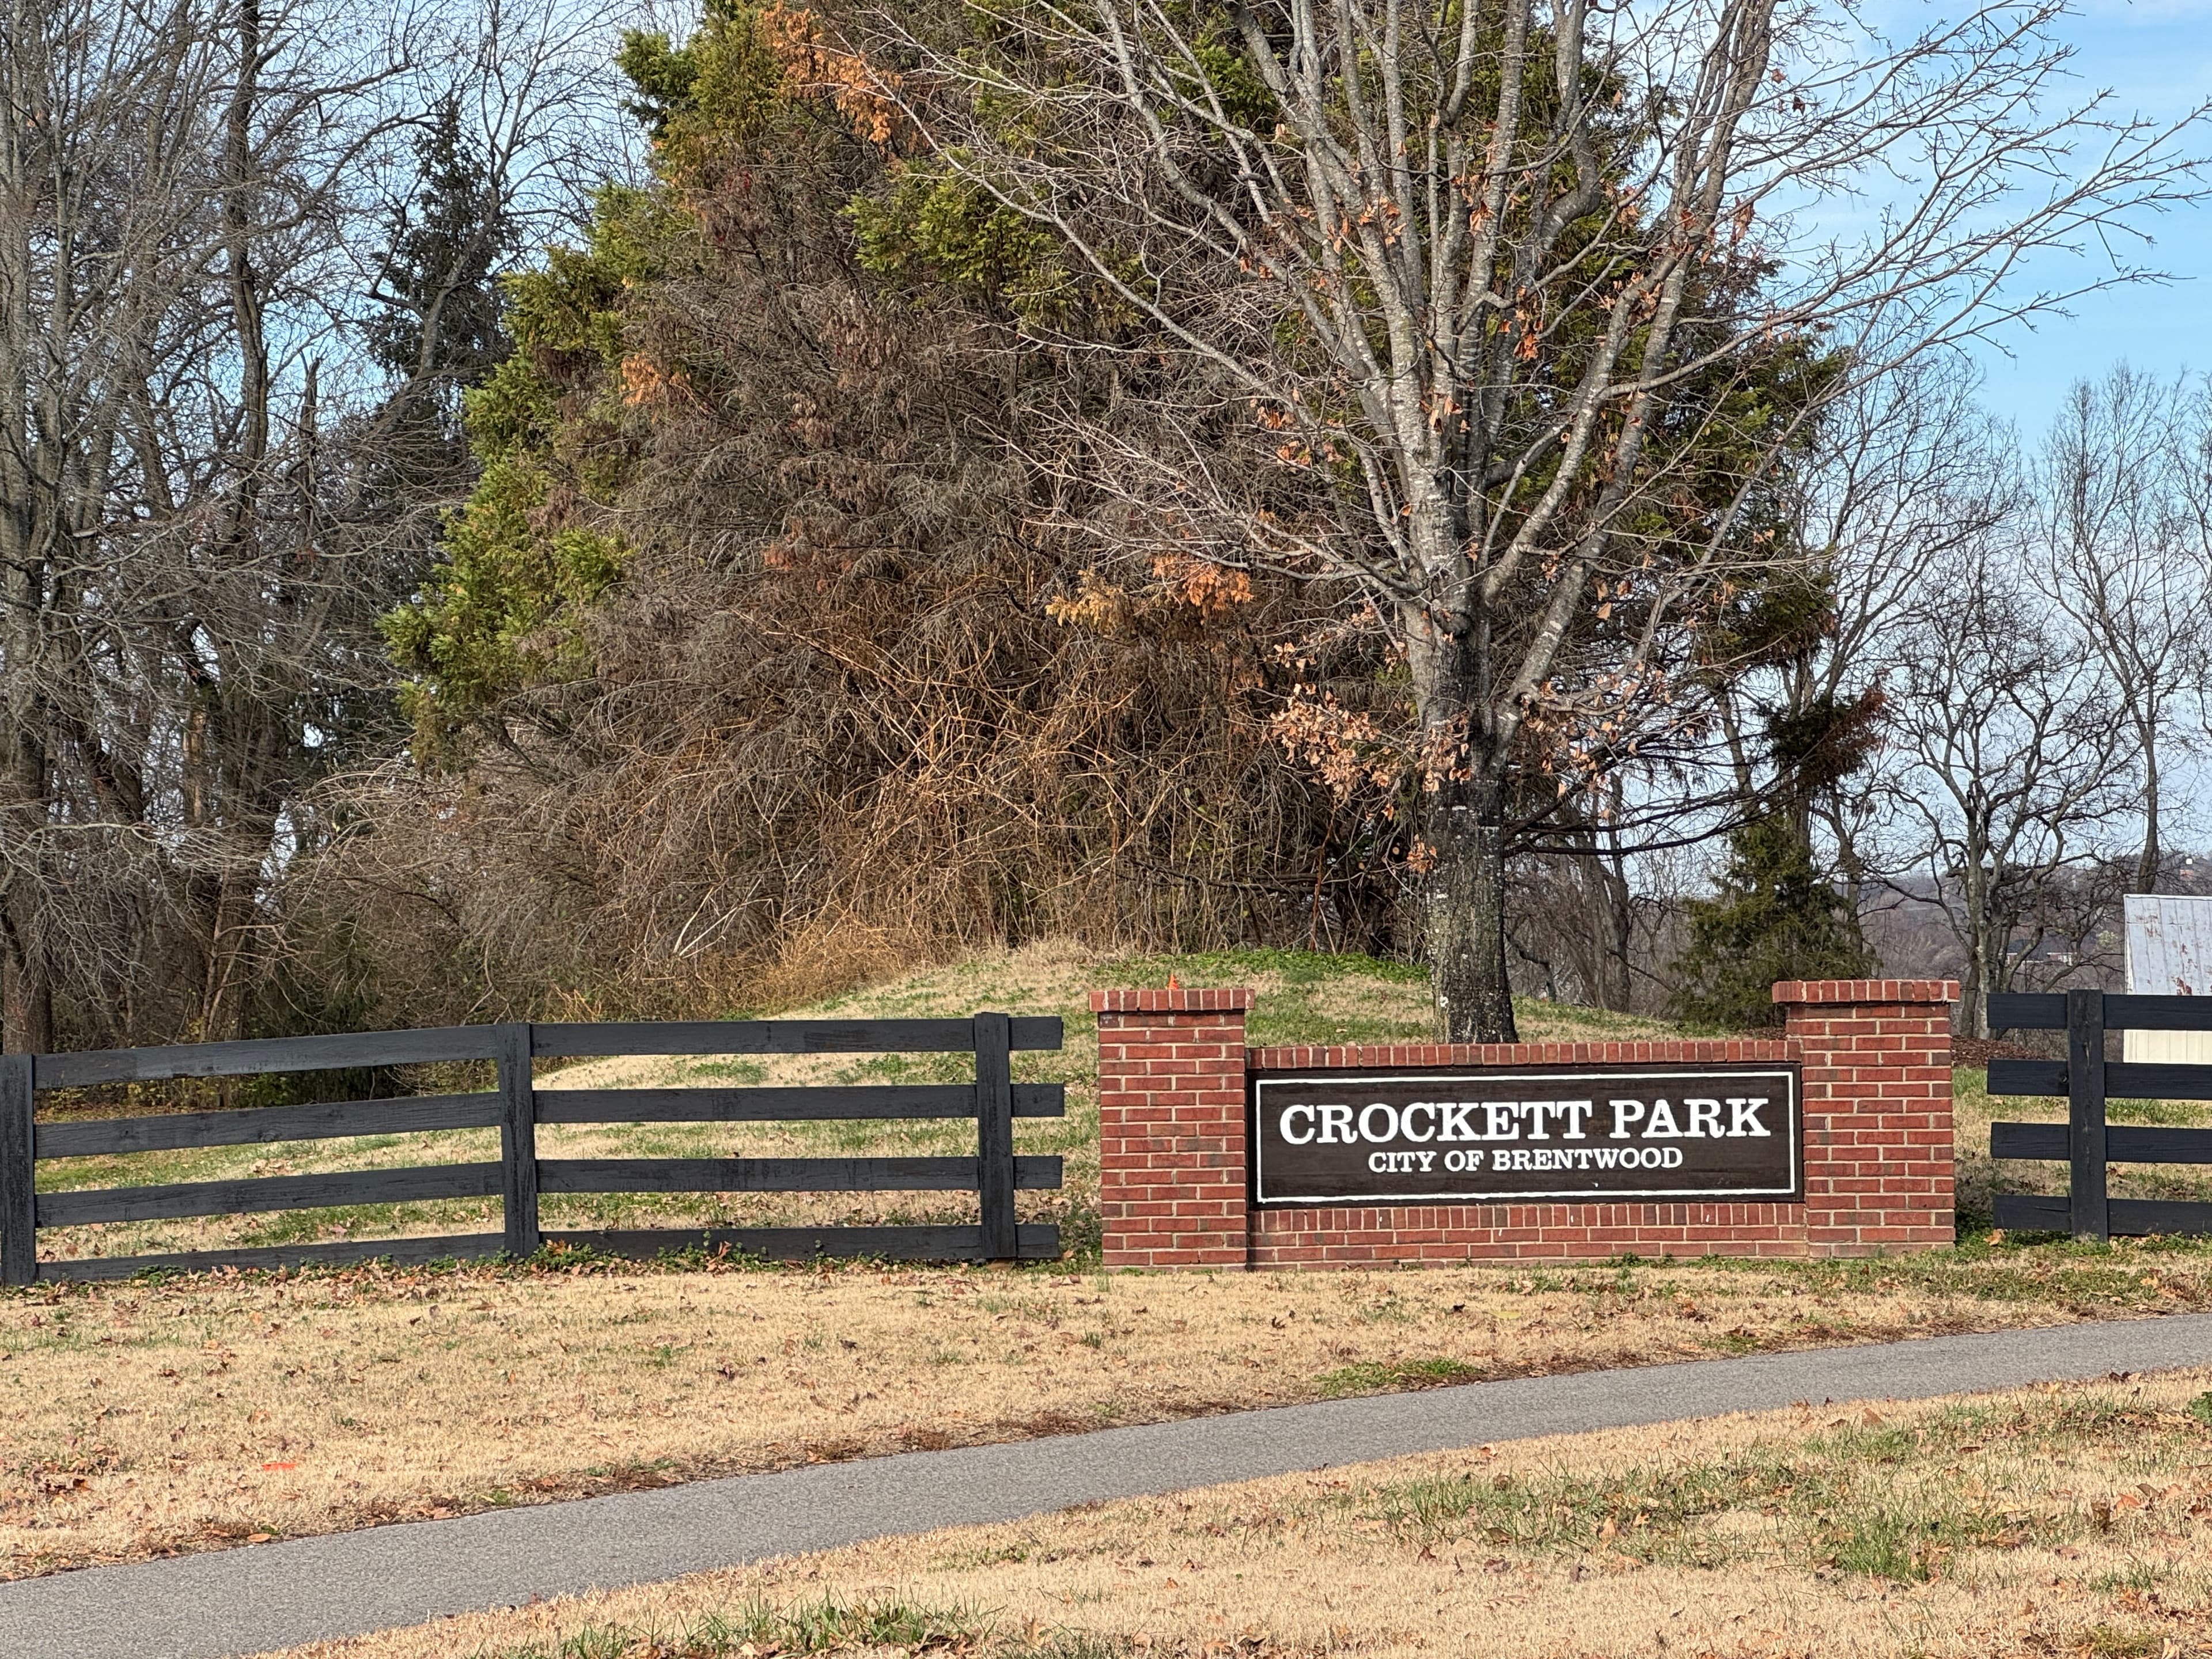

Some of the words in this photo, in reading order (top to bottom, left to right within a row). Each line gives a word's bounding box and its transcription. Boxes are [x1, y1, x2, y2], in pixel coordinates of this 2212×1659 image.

[1279, 1100, 1592, 1145] CROCKETT
[1609, 1098, 1771, 1139] PARK
[1368, 1150, 1437, 1173] CITY
[1444, 1149, 1484, 1172] OF
[1491, 1147, 1683, 1171] BRENTWOOD
